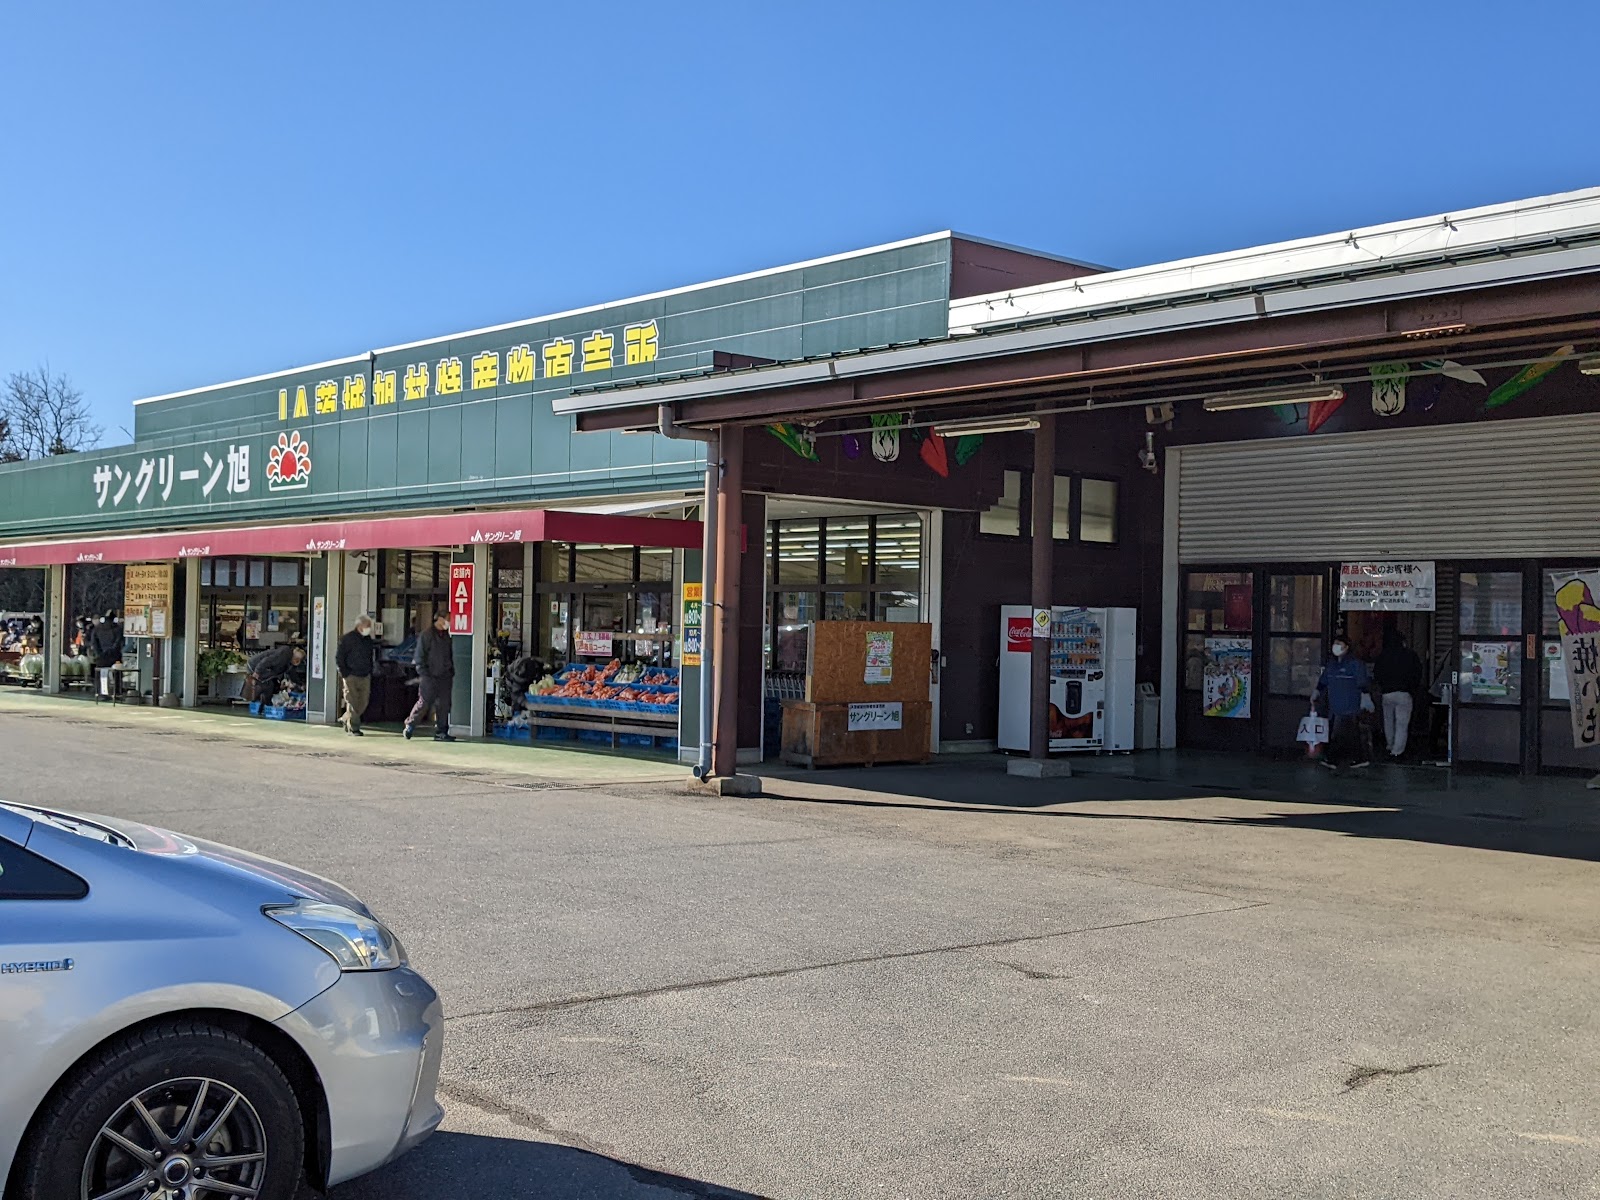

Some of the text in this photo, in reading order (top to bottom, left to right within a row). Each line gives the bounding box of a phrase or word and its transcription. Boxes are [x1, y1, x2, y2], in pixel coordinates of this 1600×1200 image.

[93, 445, 250, 508] サングリーン旭
[484, 529, 522, 542] サングリーン旭
[453, 567, 471, 579] 店舗内
[686, 586, 702, 598] 営業
[455, 581, 468, 630] ATM
[849, 710, 900, 722] サングリーン旭
[1300, 723, 1325, 734] 入口
[1, 959, 64, 974] HYBRID
